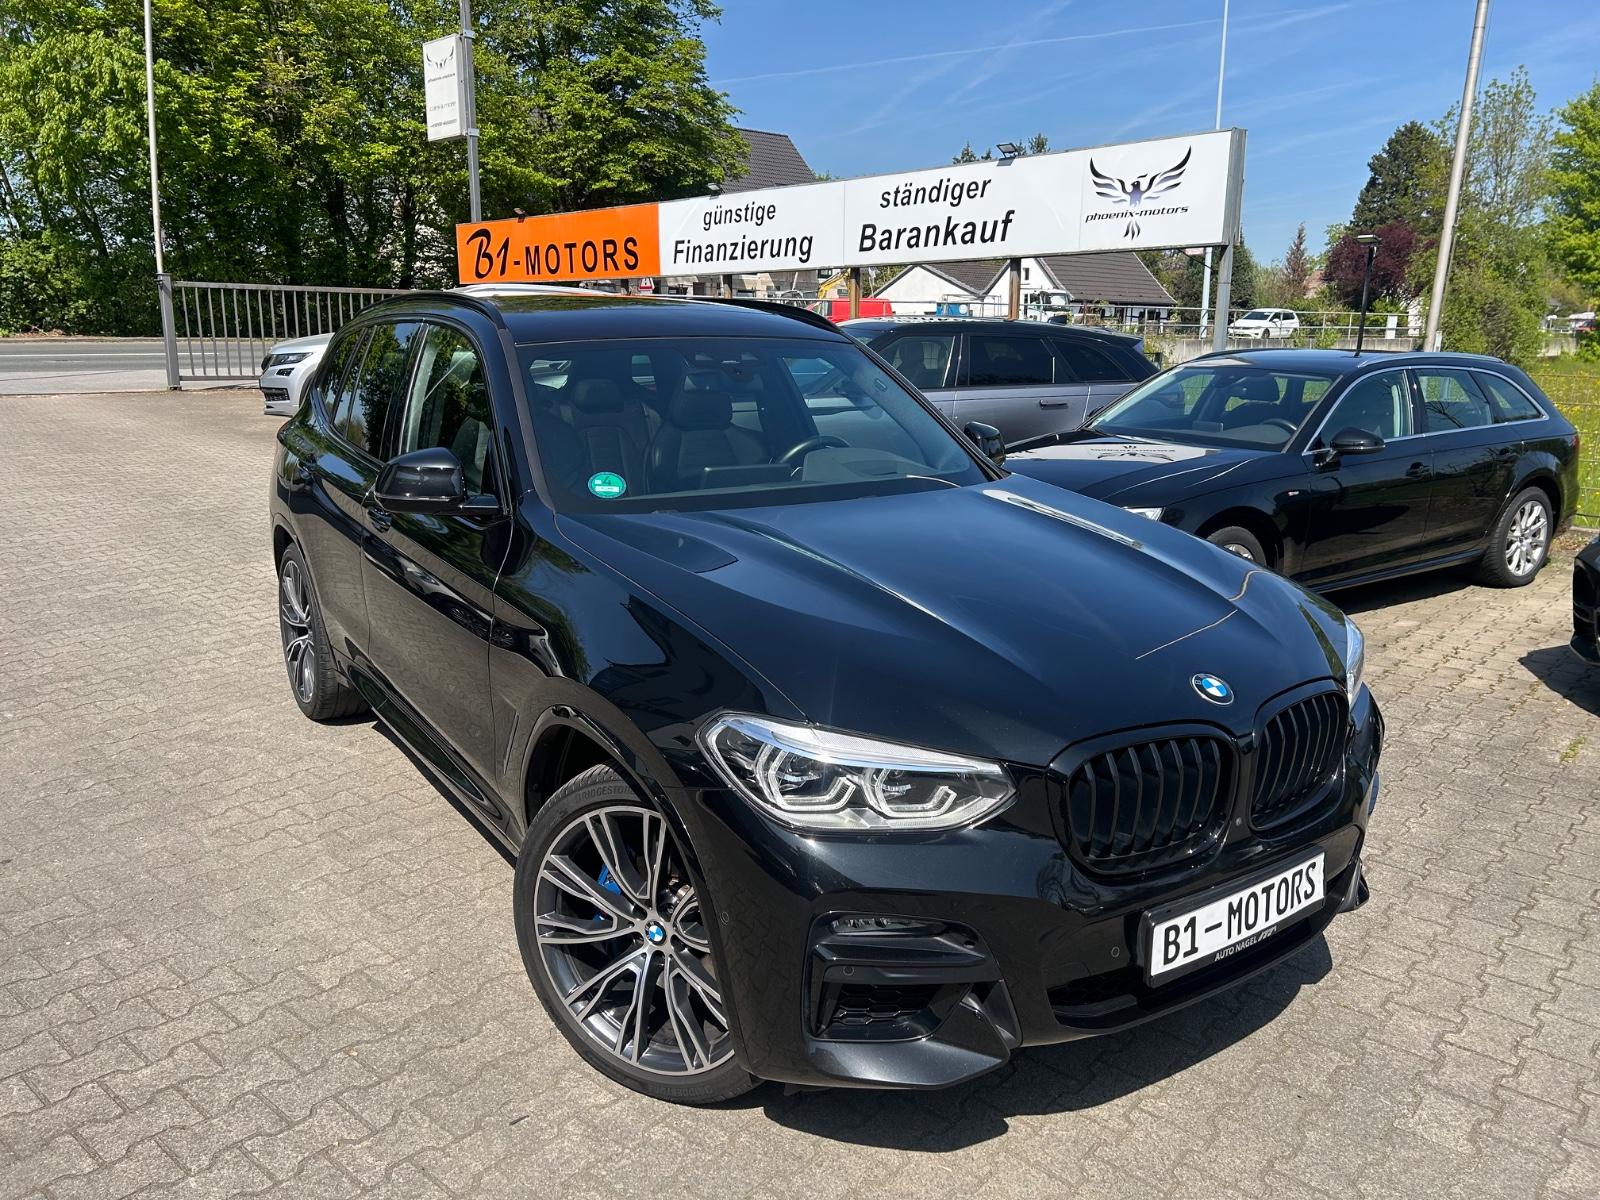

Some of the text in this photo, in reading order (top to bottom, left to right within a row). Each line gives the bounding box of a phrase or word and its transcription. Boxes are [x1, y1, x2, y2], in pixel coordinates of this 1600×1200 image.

[880, 177, 992, 209] ständiger
[703, 201, 776, 231] günstige
[858, 208, 1015, 252] Barankauf
[1085, 206, 1190, 223] phoenix-motors
[466, 228, 639, 279] B1-MOTORS
[673, 234, 814, 264] Finanzierung
[1162, 861, 1317, 966] B1-MOTORS
[1214, 935, 1258, 962] AUTO NAGEL
